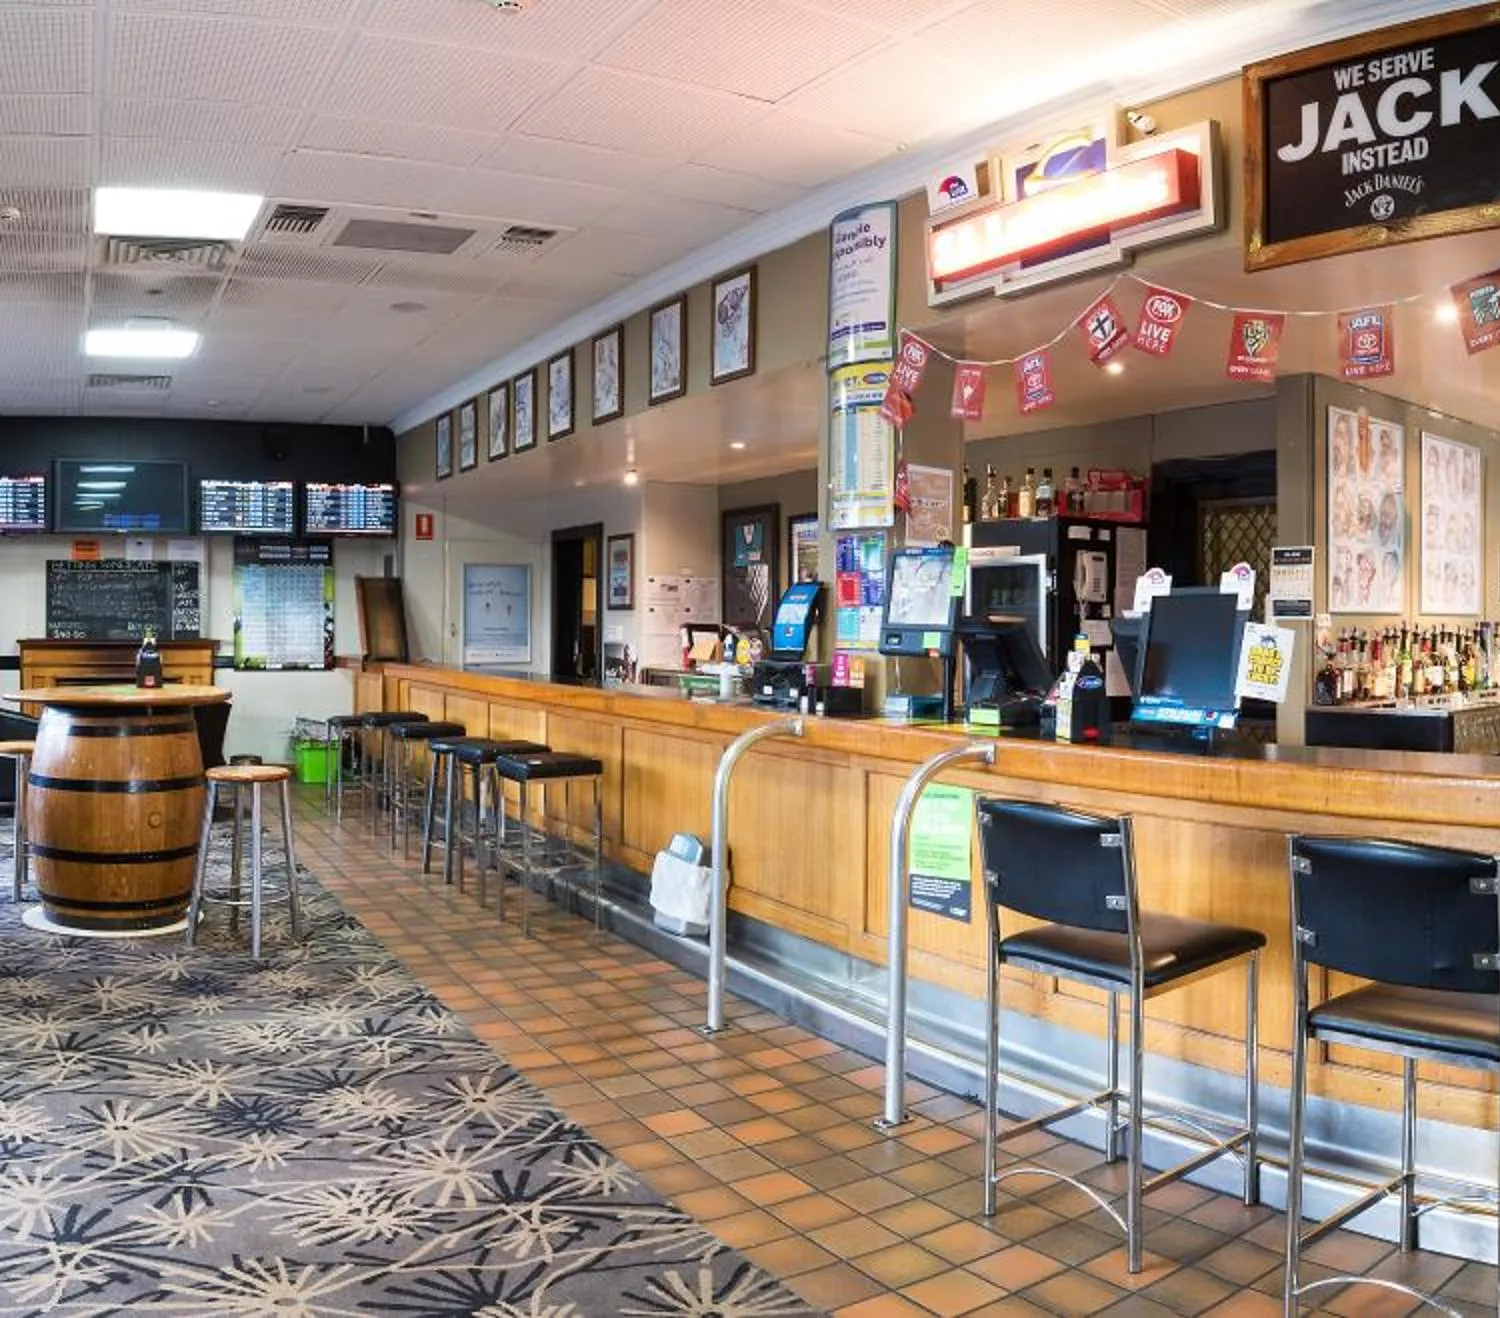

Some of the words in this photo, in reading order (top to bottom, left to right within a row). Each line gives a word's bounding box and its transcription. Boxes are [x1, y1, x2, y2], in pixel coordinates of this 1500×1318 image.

[1333, 64, 1365, 91] WE
[1368, 48, 1435, 82] SERVE
[1341, 137, 1429, 176] INSTEAD
[1344, 178, 1374, 207] JACK
[1153, 300, 1175, 314] FOX
[1351, 315, 1380, 328] AFL
[1140, 322, 1172, 340] LIVE
[1137, 337, 1166, 353] HERE
